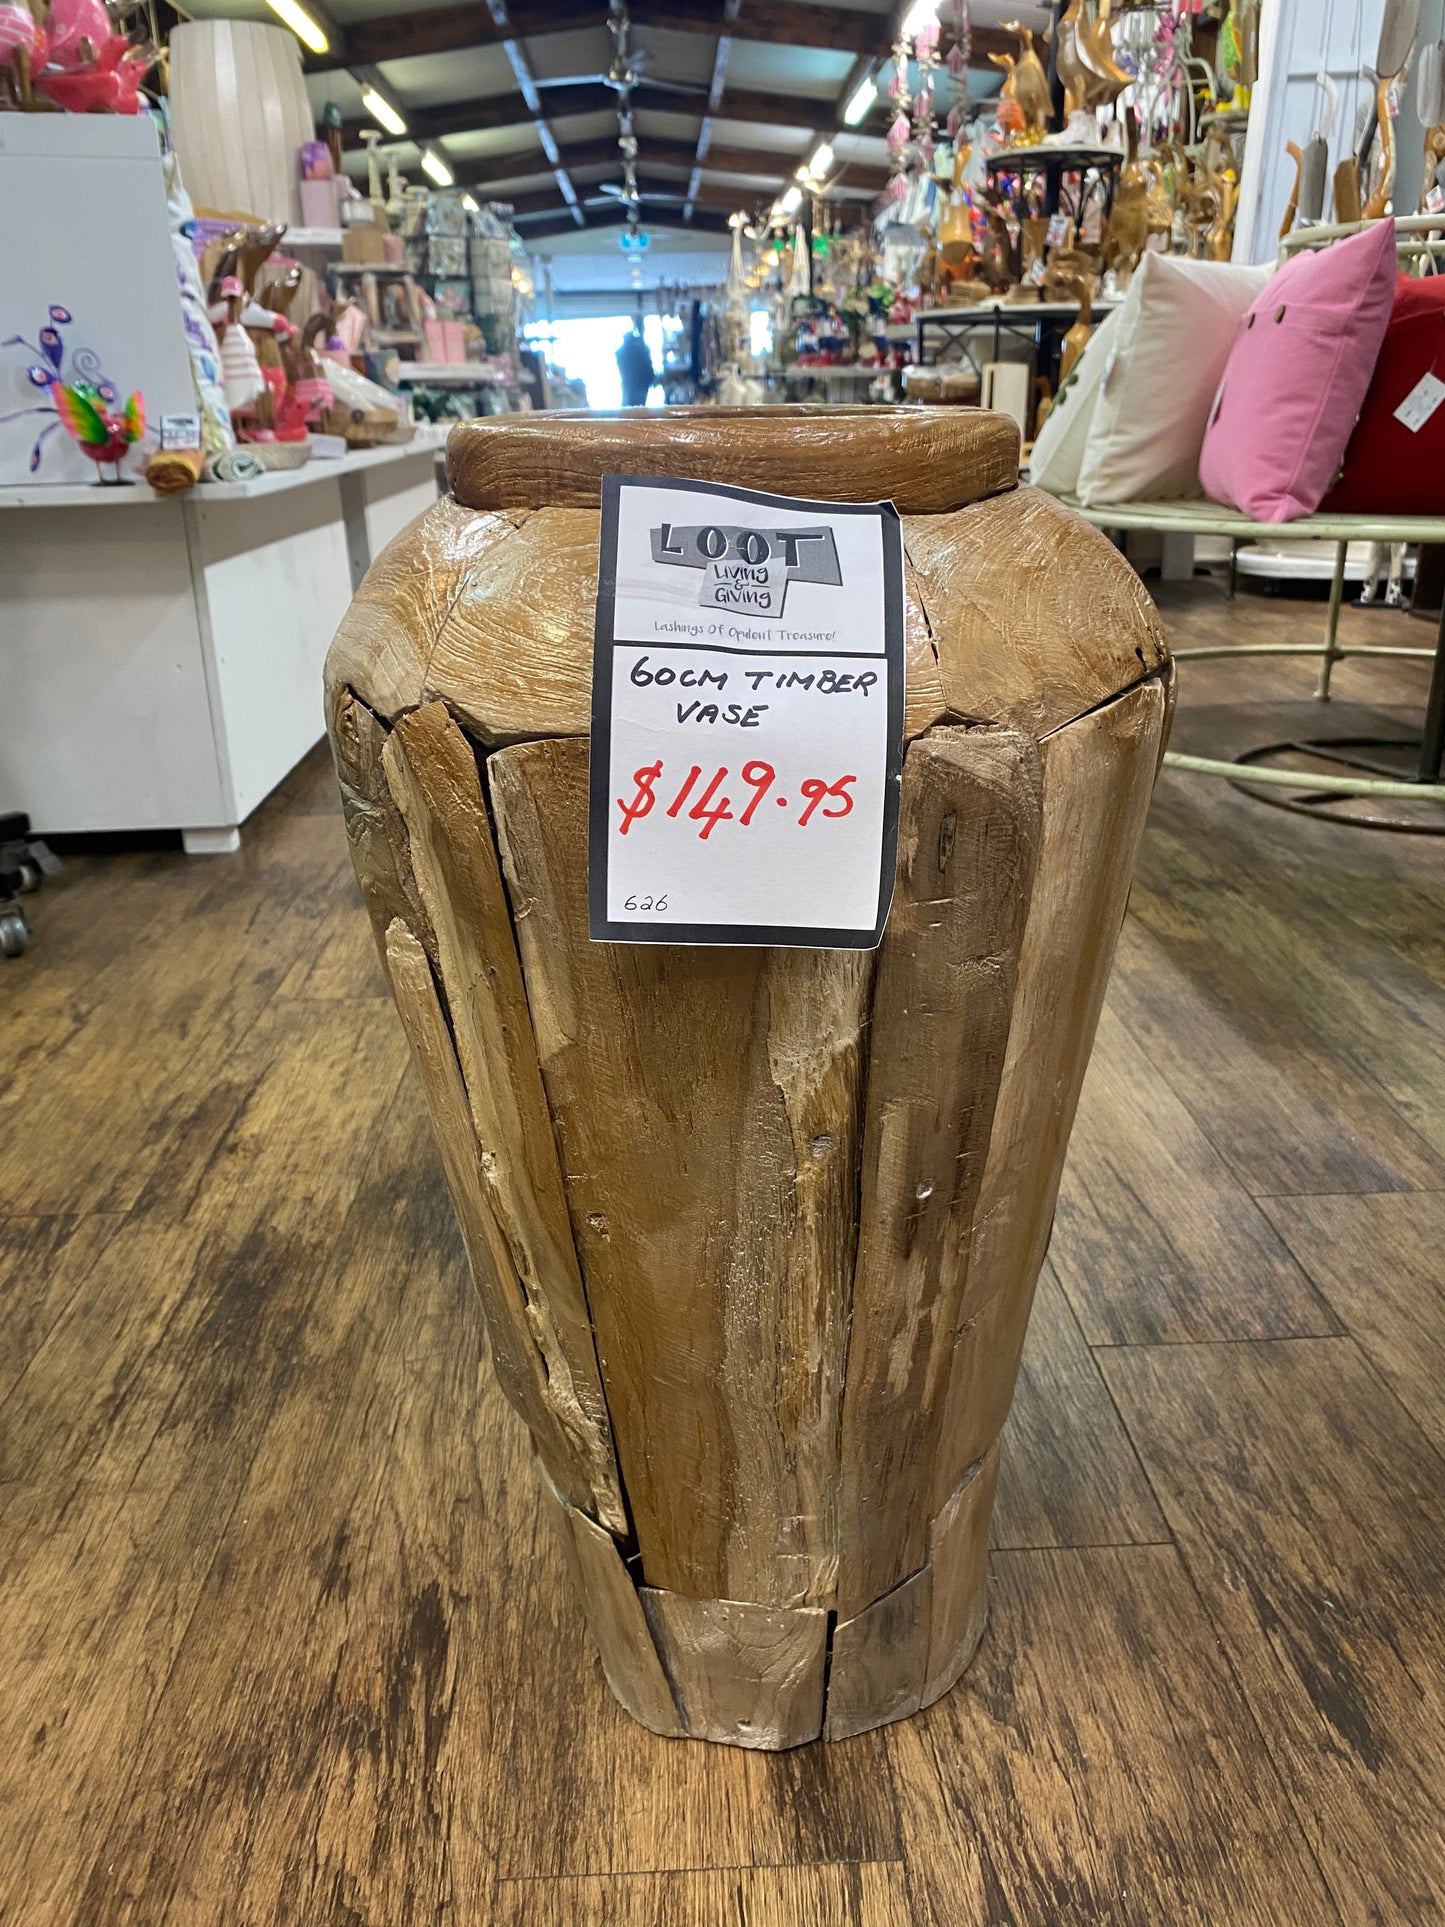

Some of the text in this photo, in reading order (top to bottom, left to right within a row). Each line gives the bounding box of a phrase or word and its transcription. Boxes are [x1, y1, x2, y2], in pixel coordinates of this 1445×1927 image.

[661, 523, 825, 567] LOOT
[713, 564, 769, 583] Living
[733, 577, 749, 591] &
[714, 587, 772, 609] Giving
[654, 620, 836, 642] Lashings Of Opulent Treasure!
[630, 656, 878, 697] 60CM TIMBER
[677, 701, 769, 727] VASE
[617, 760, 857, 839] $149.95
[623, 895, 668, 912] 626
